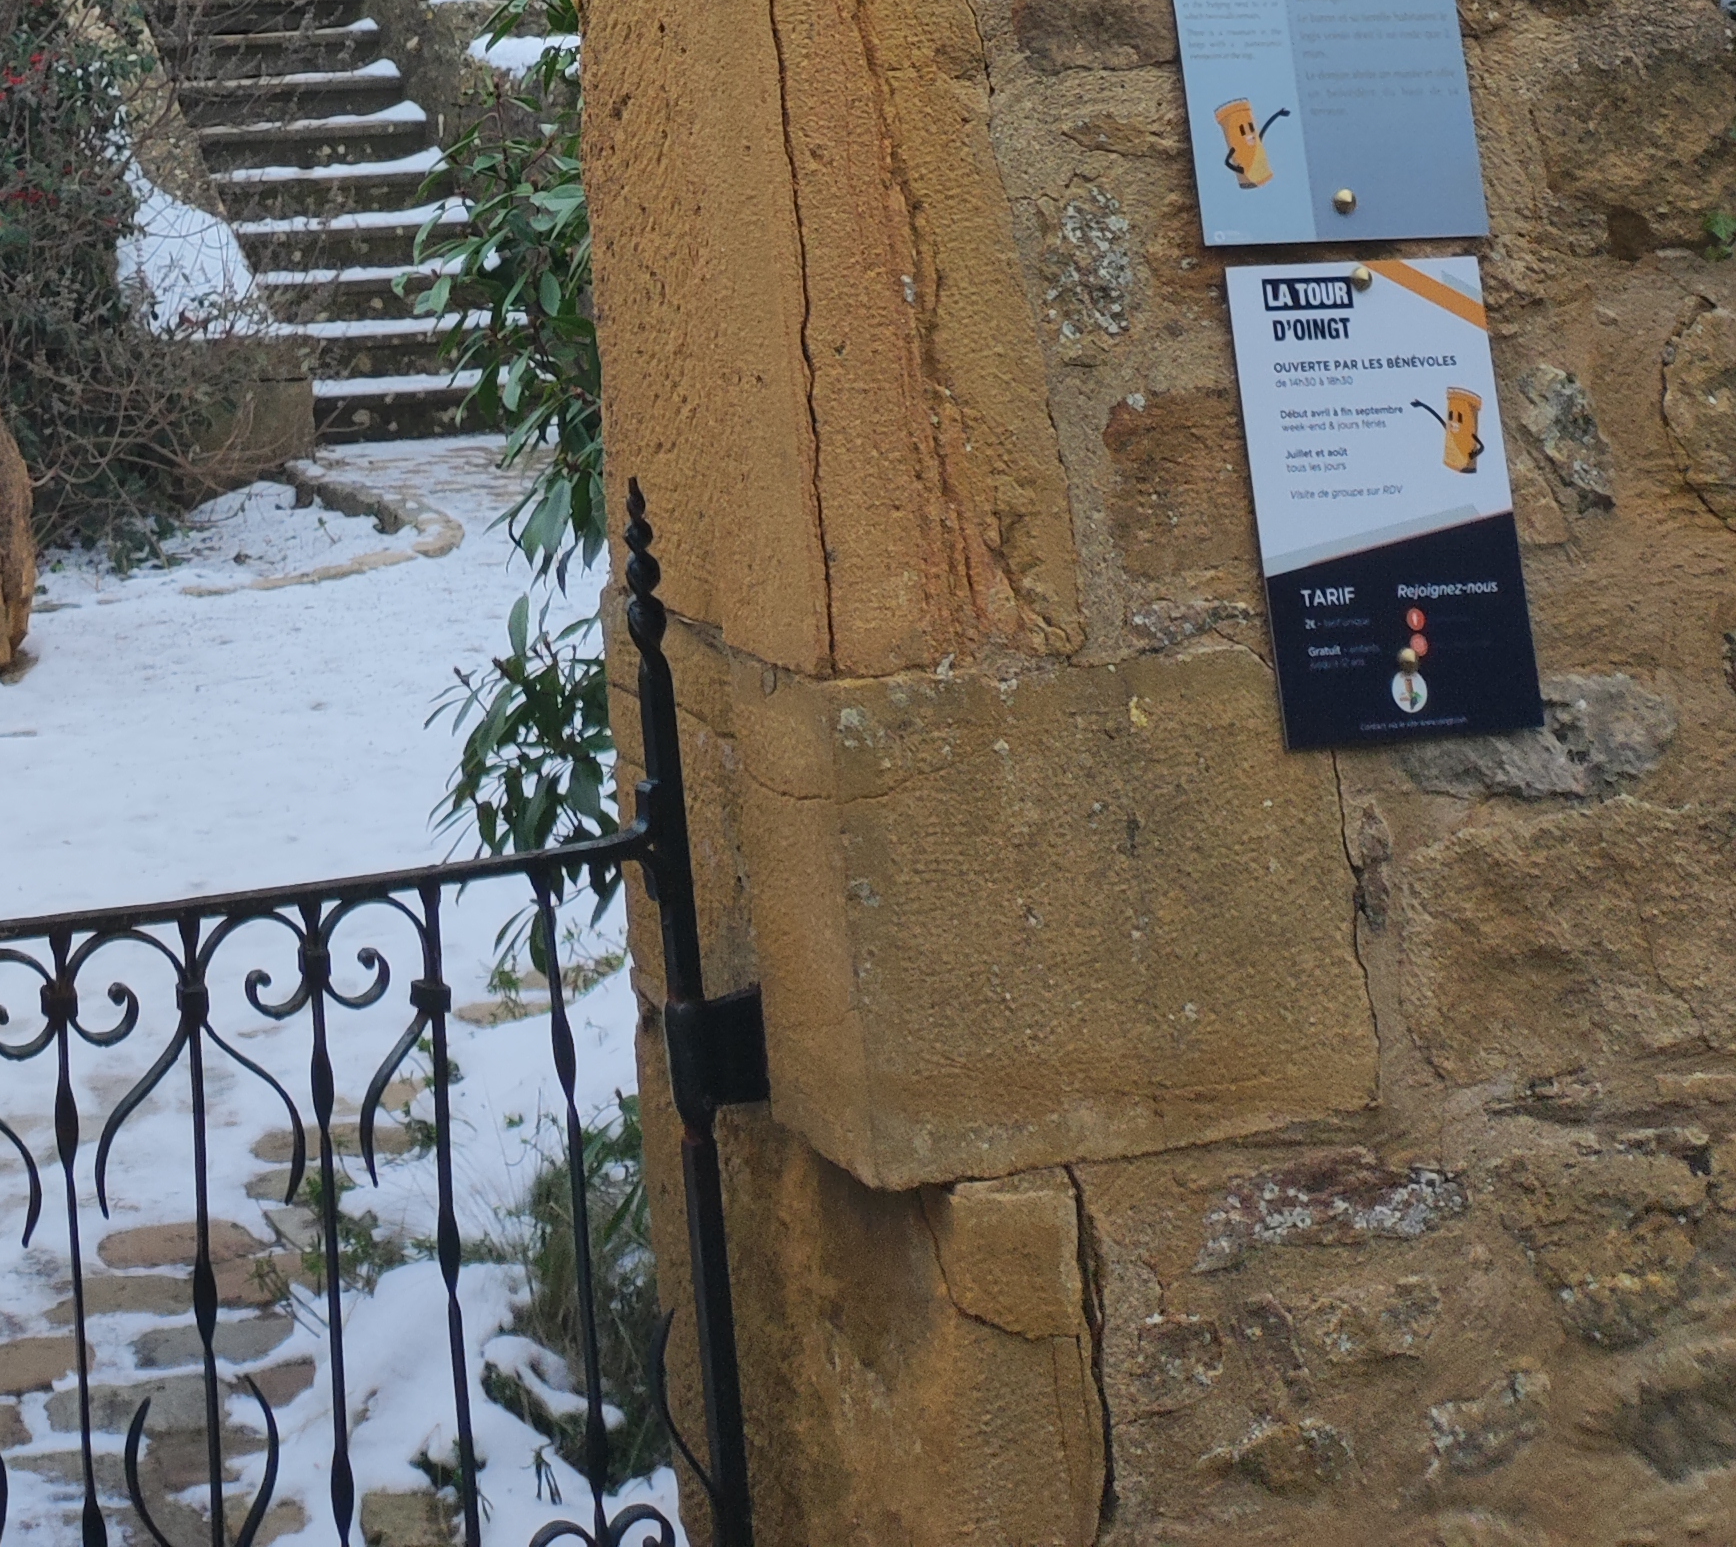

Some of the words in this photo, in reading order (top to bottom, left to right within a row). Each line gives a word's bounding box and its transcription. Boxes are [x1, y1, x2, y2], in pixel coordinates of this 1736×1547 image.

[1265, 283, 1293, 308] LA
[1295, 281, 1351, 307] TOUR
[1273, 360, 1331, 374] OUVERTE
[1334, 358, 1359, 371] PAR
[1361, 357, 1384, 370] LES
[1386, 354, 1458, 369] BÉNÉVOLES
[1280, 409, 1309, 420] Début
[1310, 408, 1331, 418] avril
[1340, 406, 1354, 417] fin
[1355, 405, 1404, 417] septembre
[1285, 448, 1313, 460] Juillet
[1315, 449, 1325, 459] et
[1300, 586, 1356, 608] TARIF
[1396, 580, 1499, 600] Rejoignez-nous
[1308, 644, 1342, 658] Gratuit
